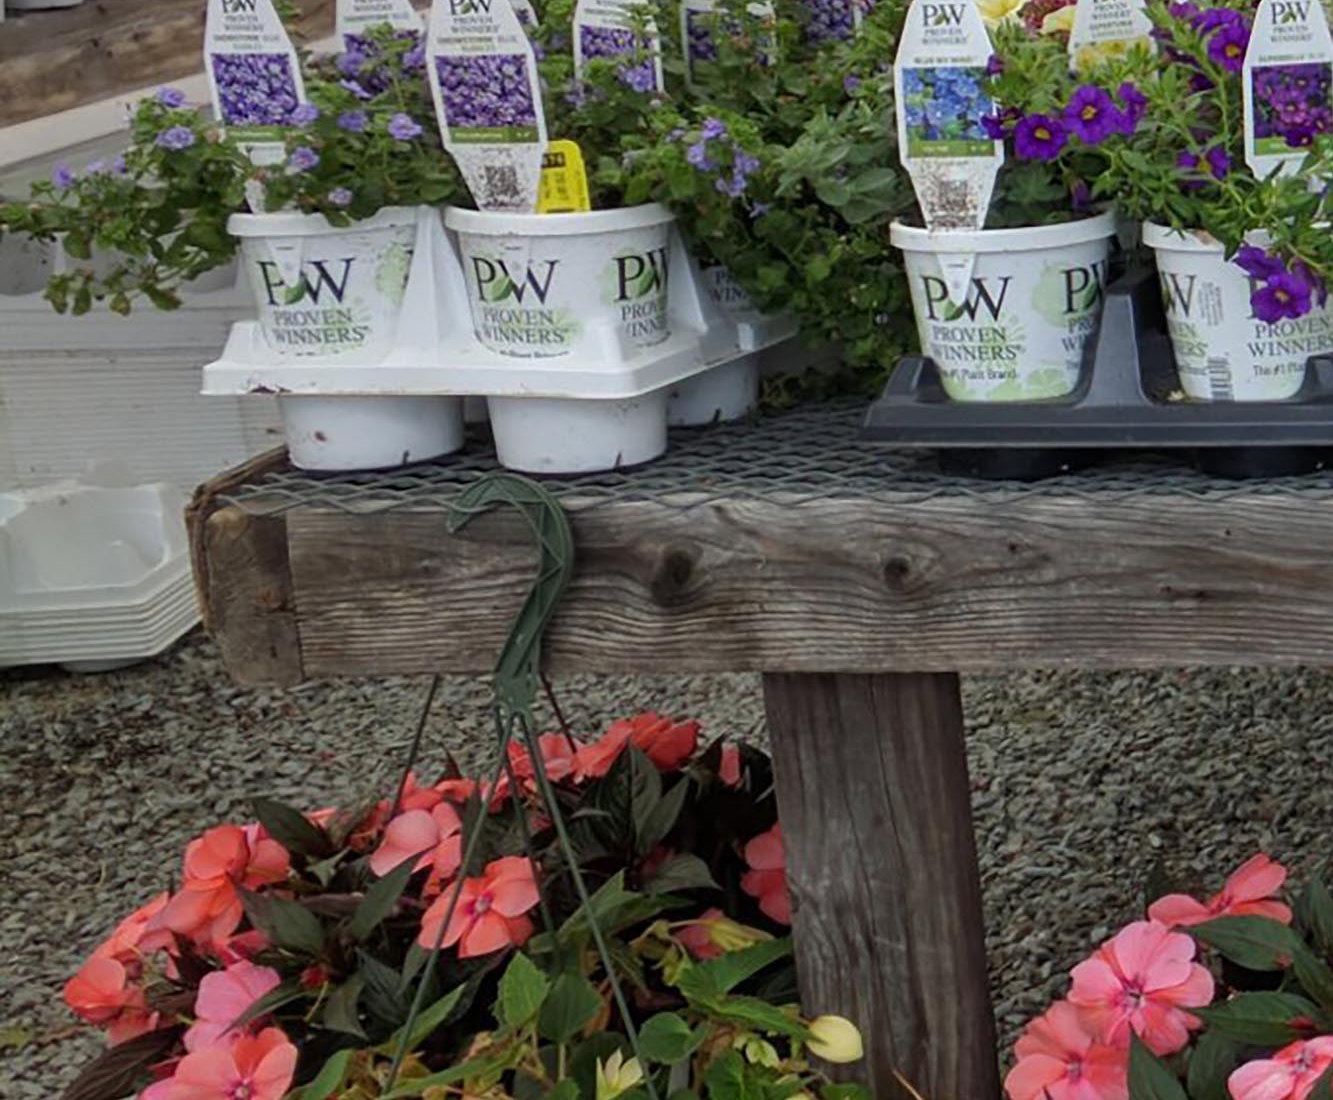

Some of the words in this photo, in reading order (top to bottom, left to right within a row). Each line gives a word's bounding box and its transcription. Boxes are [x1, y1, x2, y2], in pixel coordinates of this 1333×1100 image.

[922, 3, 967, 27] PW
[1271, 0, 1311, 25] PW
[470, 254, 560, 306] PW
[919, 275, 1014, 323] PW
[272, 307, 353, 327] PROVEN
[483, 308, 555, 326] PROVEN
[1255, 317, 1332, 340] PROVEN
[932, 326, 1007, 342] PROVEN
